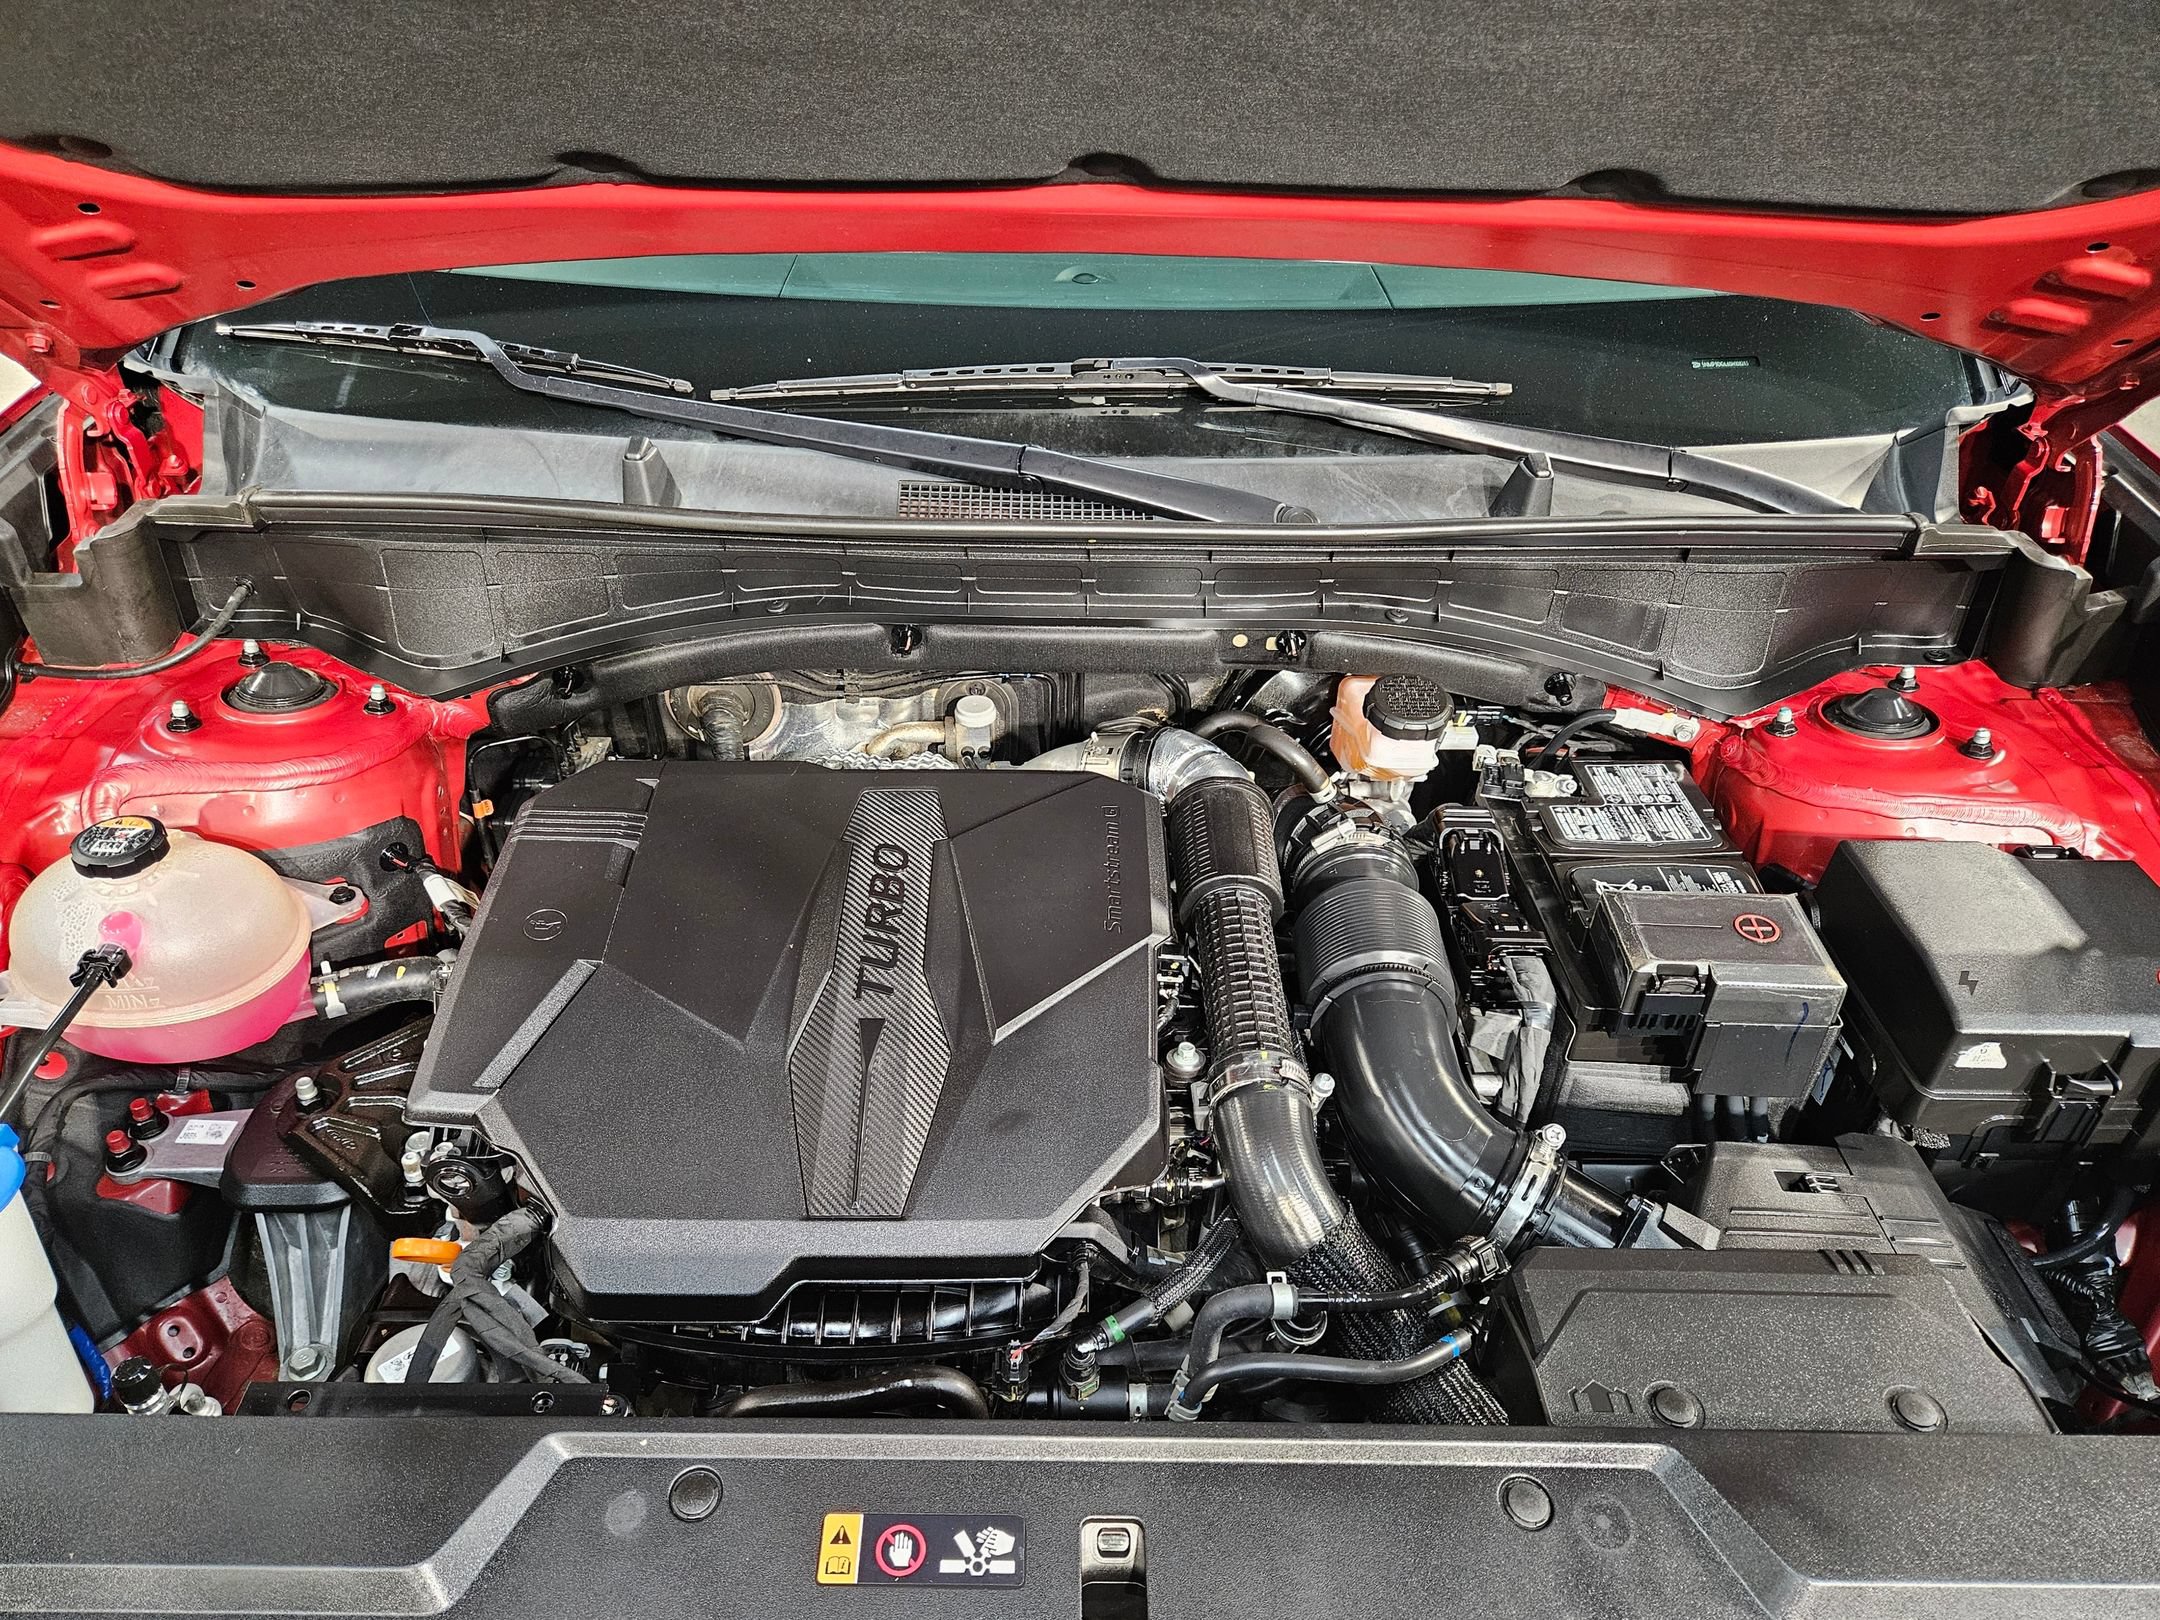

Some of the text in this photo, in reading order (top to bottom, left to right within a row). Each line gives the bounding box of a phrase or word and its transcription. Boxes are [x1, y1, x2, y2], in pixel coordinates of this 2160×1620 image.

[854, 842, 909, 999] TURBO
[1103, 821, 1122, 934] Smartstream
[105, 994, 148, 1010] MIN
